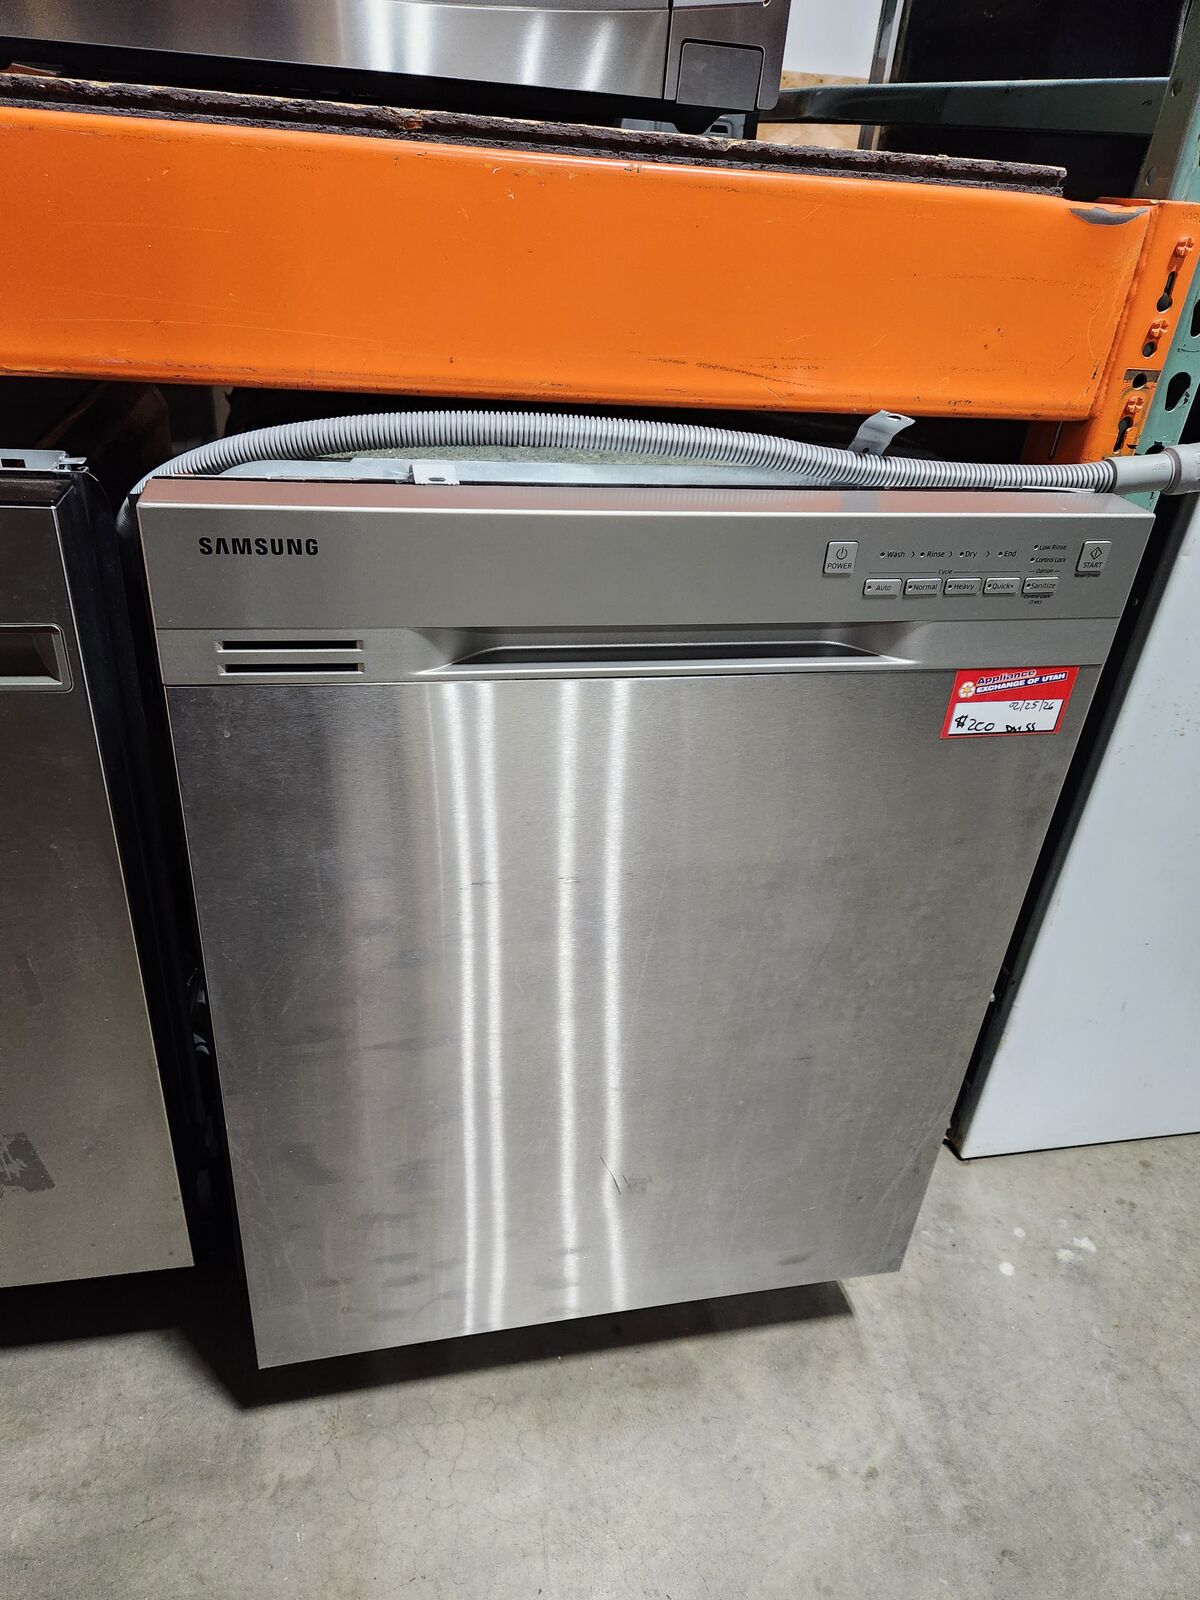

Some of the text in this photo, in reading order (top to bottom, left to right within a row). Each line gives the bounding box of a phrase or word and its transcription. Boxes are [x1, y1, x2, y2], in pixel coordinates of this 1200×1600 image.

[198, 537, 319, 556] SAMSUNG
[965, 551, 978, 559] Dry
[976, 669, 1036, 685] Appliance
[976, 672, 1067, 693] EXCHANGE OF UTAH
